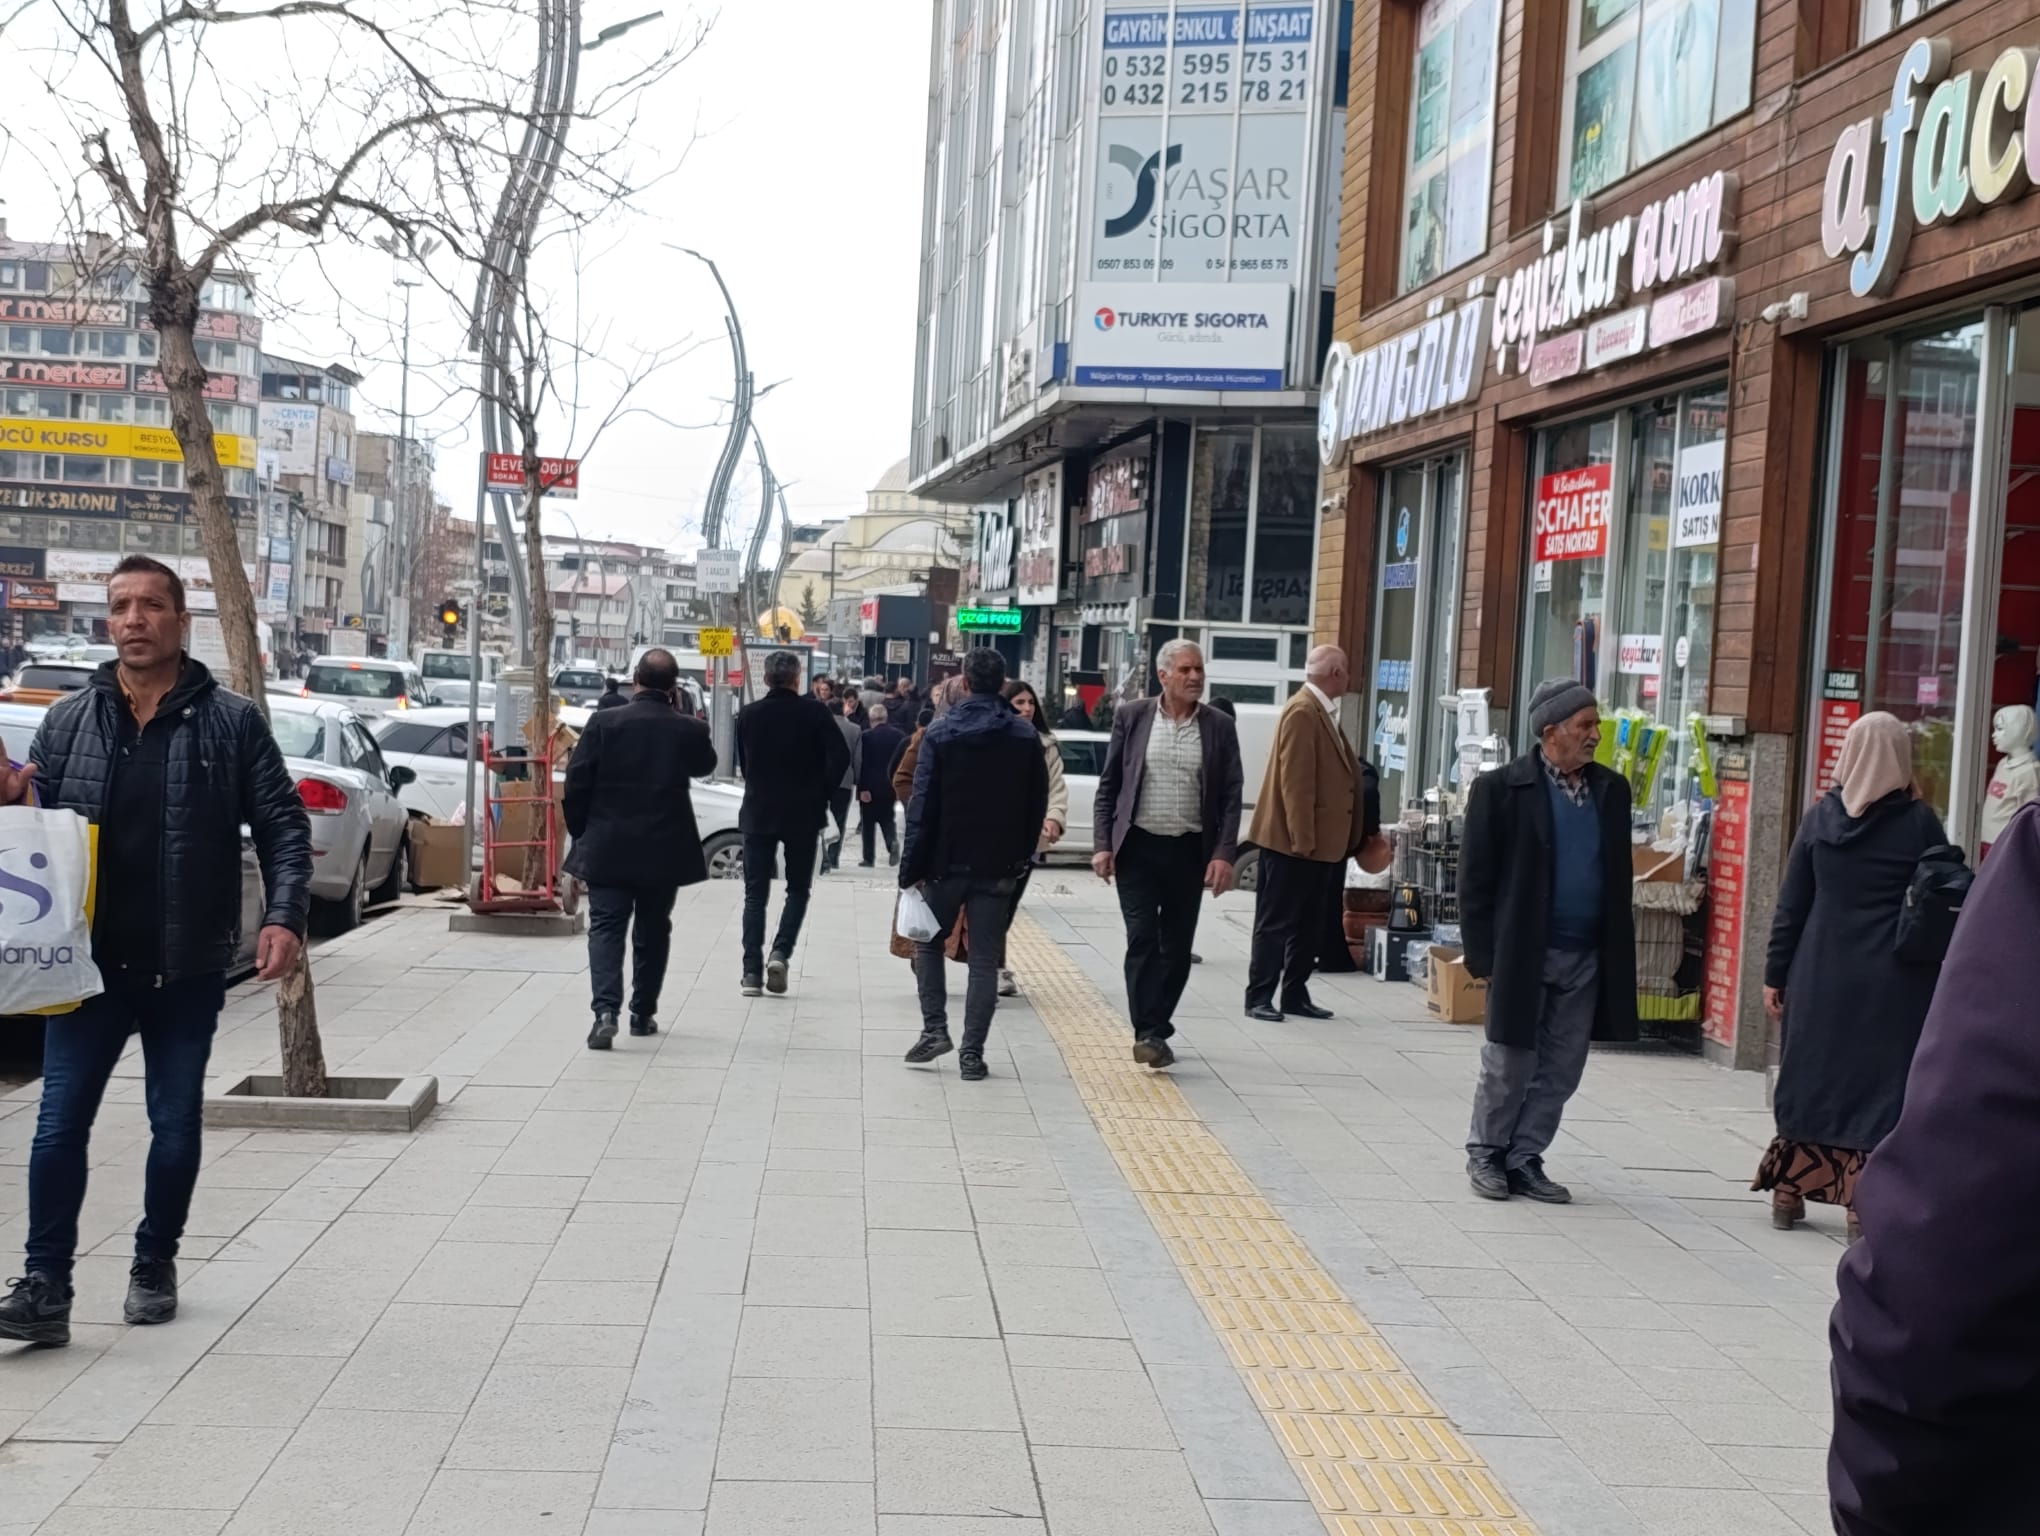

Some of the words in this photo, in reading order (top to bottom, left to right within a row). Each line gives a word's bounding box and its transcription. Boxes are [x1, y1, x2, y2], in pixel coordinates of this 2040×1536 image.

[1107, 14, 1226, 43] GAYRİMENKUL
[1247, 12, 1311, 43] İNŞAAT
[1105, 57, 1117, 77] 0
[1125, 55, 1166, 76] 532
[1183, 53, 1230, 75] 595
[1244, 51, 1271, 73] 75
[1281, 50, 1307, 71] 31
[1104, 85, 1116, 106] 0
[1124, 83, 1164, 105] 432
[1180, 82, 1228, 104] 215
[1242, 80, 1270, 102] 78
[1279, 79, 1306, 101] 21
[1821, 37, 2040, 298] afac
[1151, 167, 1291, 210] YAŞAR
[1148, 210, 1290, 239] SİGORTA
[1632, 170, 1724, 293] avm
[1098, 259, 1121, 270] 0507
[1340, 277, 1484, 441] VANGÖLÜ
[19, 361, 127, 386] merkezi
[41, 430, 108, 448] KURSU
[48, 491, 117, 511] SALONU
[1536, 489, 1611, 536] SCHAFER
[1682, 515, 1709, 540] SATIŞ
[1545, 535, 1564, 559] SATIŞ
[1565, 530, 1599, 554] NOKTASI
[990, 614, 1020, 625] FOTO
